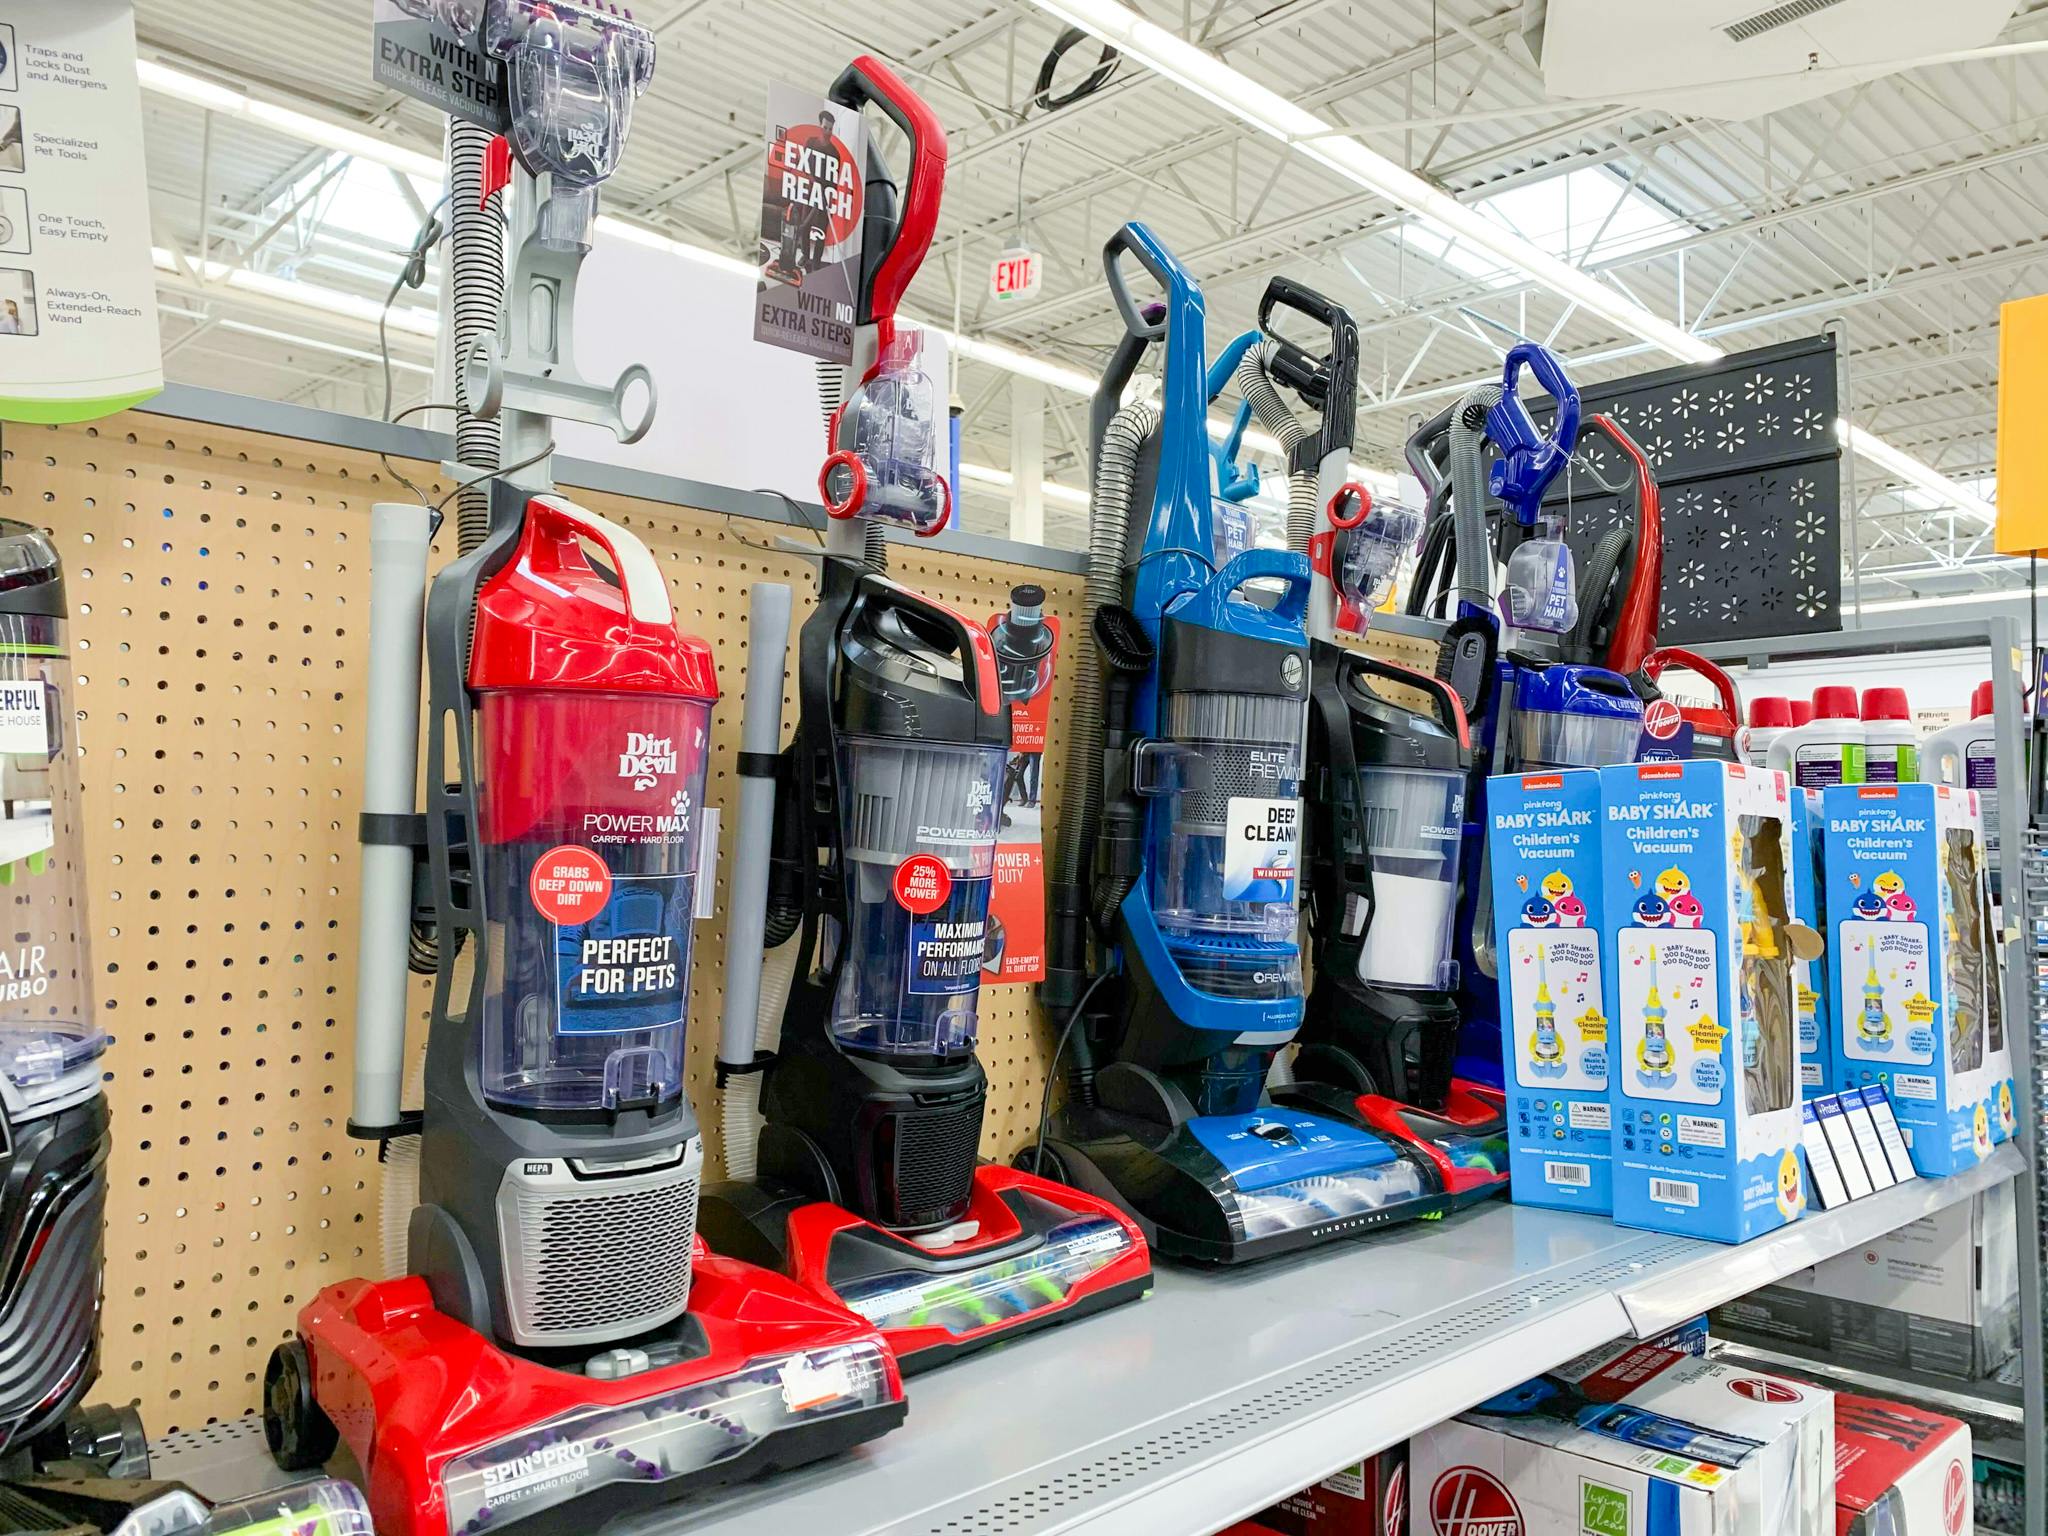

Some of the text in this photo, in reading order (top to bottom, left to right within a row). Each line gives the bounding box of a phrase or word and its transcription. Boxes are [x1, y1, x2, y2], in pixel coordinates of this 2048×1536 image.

[25, 44, 83, 62] Traps and
[429, 33, 498, 84] WITH N
[25, 57, 91, 75] Locks Dust
[380, 37, 497, 107] EXTRA STEP
[26, 71, 108, 90] and Allergens
[380, 65, 484, 118] QUICK-RELEASE VACUUM
[33, 132, 98, 150] Specialized
[34, 145, 88, 161] Pet Tools
[784, 140, 854, 190] EXTRA
[781, 171, 853, 220] REACH
[38, 213, 105, 230] One Touch,
[39, 226, 108, 242] Easy Empty
[996, 258, 1031, 293] EXIT
[46, 288, 111, 302] Always-On,
[47, 300, 142, 317] Extended-Reach
[797, 289, 853, 324] WITH NO
[48, 313, 82, 324] Wand
[761, 304, 851, 346] EXTRA STEPS
[1227, 526, 1244, 540] PET
[1228, 539, 1244, 550] HAIR
[1549, 593, 1566, 607] PET
[1543, 605, 1565, 619] HAIR
[8, 715, 41, 726] HOUSE
[627, 732, 672, 757] Dirt
[1015, 735, 1045, 745] SUCTION
[618, 750, 677, 778] Devil
[1250, 751, 1286, 764] ELITE
[1250, 763, 1301, 781] REWIN
[971, 780, 991, 795] Dirt
[1639, 791, 1681, 803] pinkfong
[1523, 800, 1562, 812] pinkfong
[1608, 800, 1713, 820] BABY SHARK
[1858, 808, 1897, 818] pinkfong
[1267, 807, 1296, 824] DEEP
[1495, 808, 1592, 829] BABY SHARK
[583, 813, 690, 833] POWER MAX
[1830, 816, 1927, 833] BABY SHARK
[591, 834, 684, 844] CARPET HARD FLOOR
[1512, 833, 1580, 846] Children's
[1626, 827, 1700, 840] Children's
[1632, 842, 1693, 854] Vacuum
[1846, 837, 1913, 848] Children's
[1518, 847, 1575, 860] Vacuum
[1852, 850, 1908, 860] Vacuum
[553, 866, 590, 879] GRABS
[912, 865, 936, 877] 25%
[998, 869, 1024, 883] DUTY
[539, 879, 603, 893] DEEP DOWN
[909, 877, 937, 889] MORE
[557, 893, 583, 906] DIRT
[582, 936, 673, 965] PERFECT
[1566, 949, 1579, 957] DOO
[1580, 951, 1593, 959] DOO
[1664, 951, 1710, 963] DOO DOO DOO
[1005, 955, 1040, 966] EASY-EMPTY
[1550, 956, 1578, 964] DOO DOO
[1662, 959, 1692, 967] DOO DOO
[923, 961, 938, 977] ON
[942, 960, 957, 976] ALL
[1005, 965, 1013, 973] XL
[1013, 964, 1027, 973] DIRT
[580, 963, 676, 994] FOR PETS
[1577, 1022, 1608, 1030] Cleaning
[1690, 1029, 1724, 1039] Cleaning
[1695, 1037, 1718, 1045] Power
[1697, 1075, 1719, 1083] Lights
[1583, 1105, 1607, 1113] WARNING:
[1692, 1119, 1719, 1129] WARNING:
[526, 1164, 548, 1173] HEPA
[1311, 1213, 1391, 1237] WINDTUNNEL
[486, 1468, 590, 1509] CARPET HARD FLOOR
[1438, 1472, 1518, 1536] HOOVER
[1583, 1483, 1627, 1519] Living
[1315, 1504, 1326, 1514] HAS
[1586, 1506, 1626, 1531] Clean
